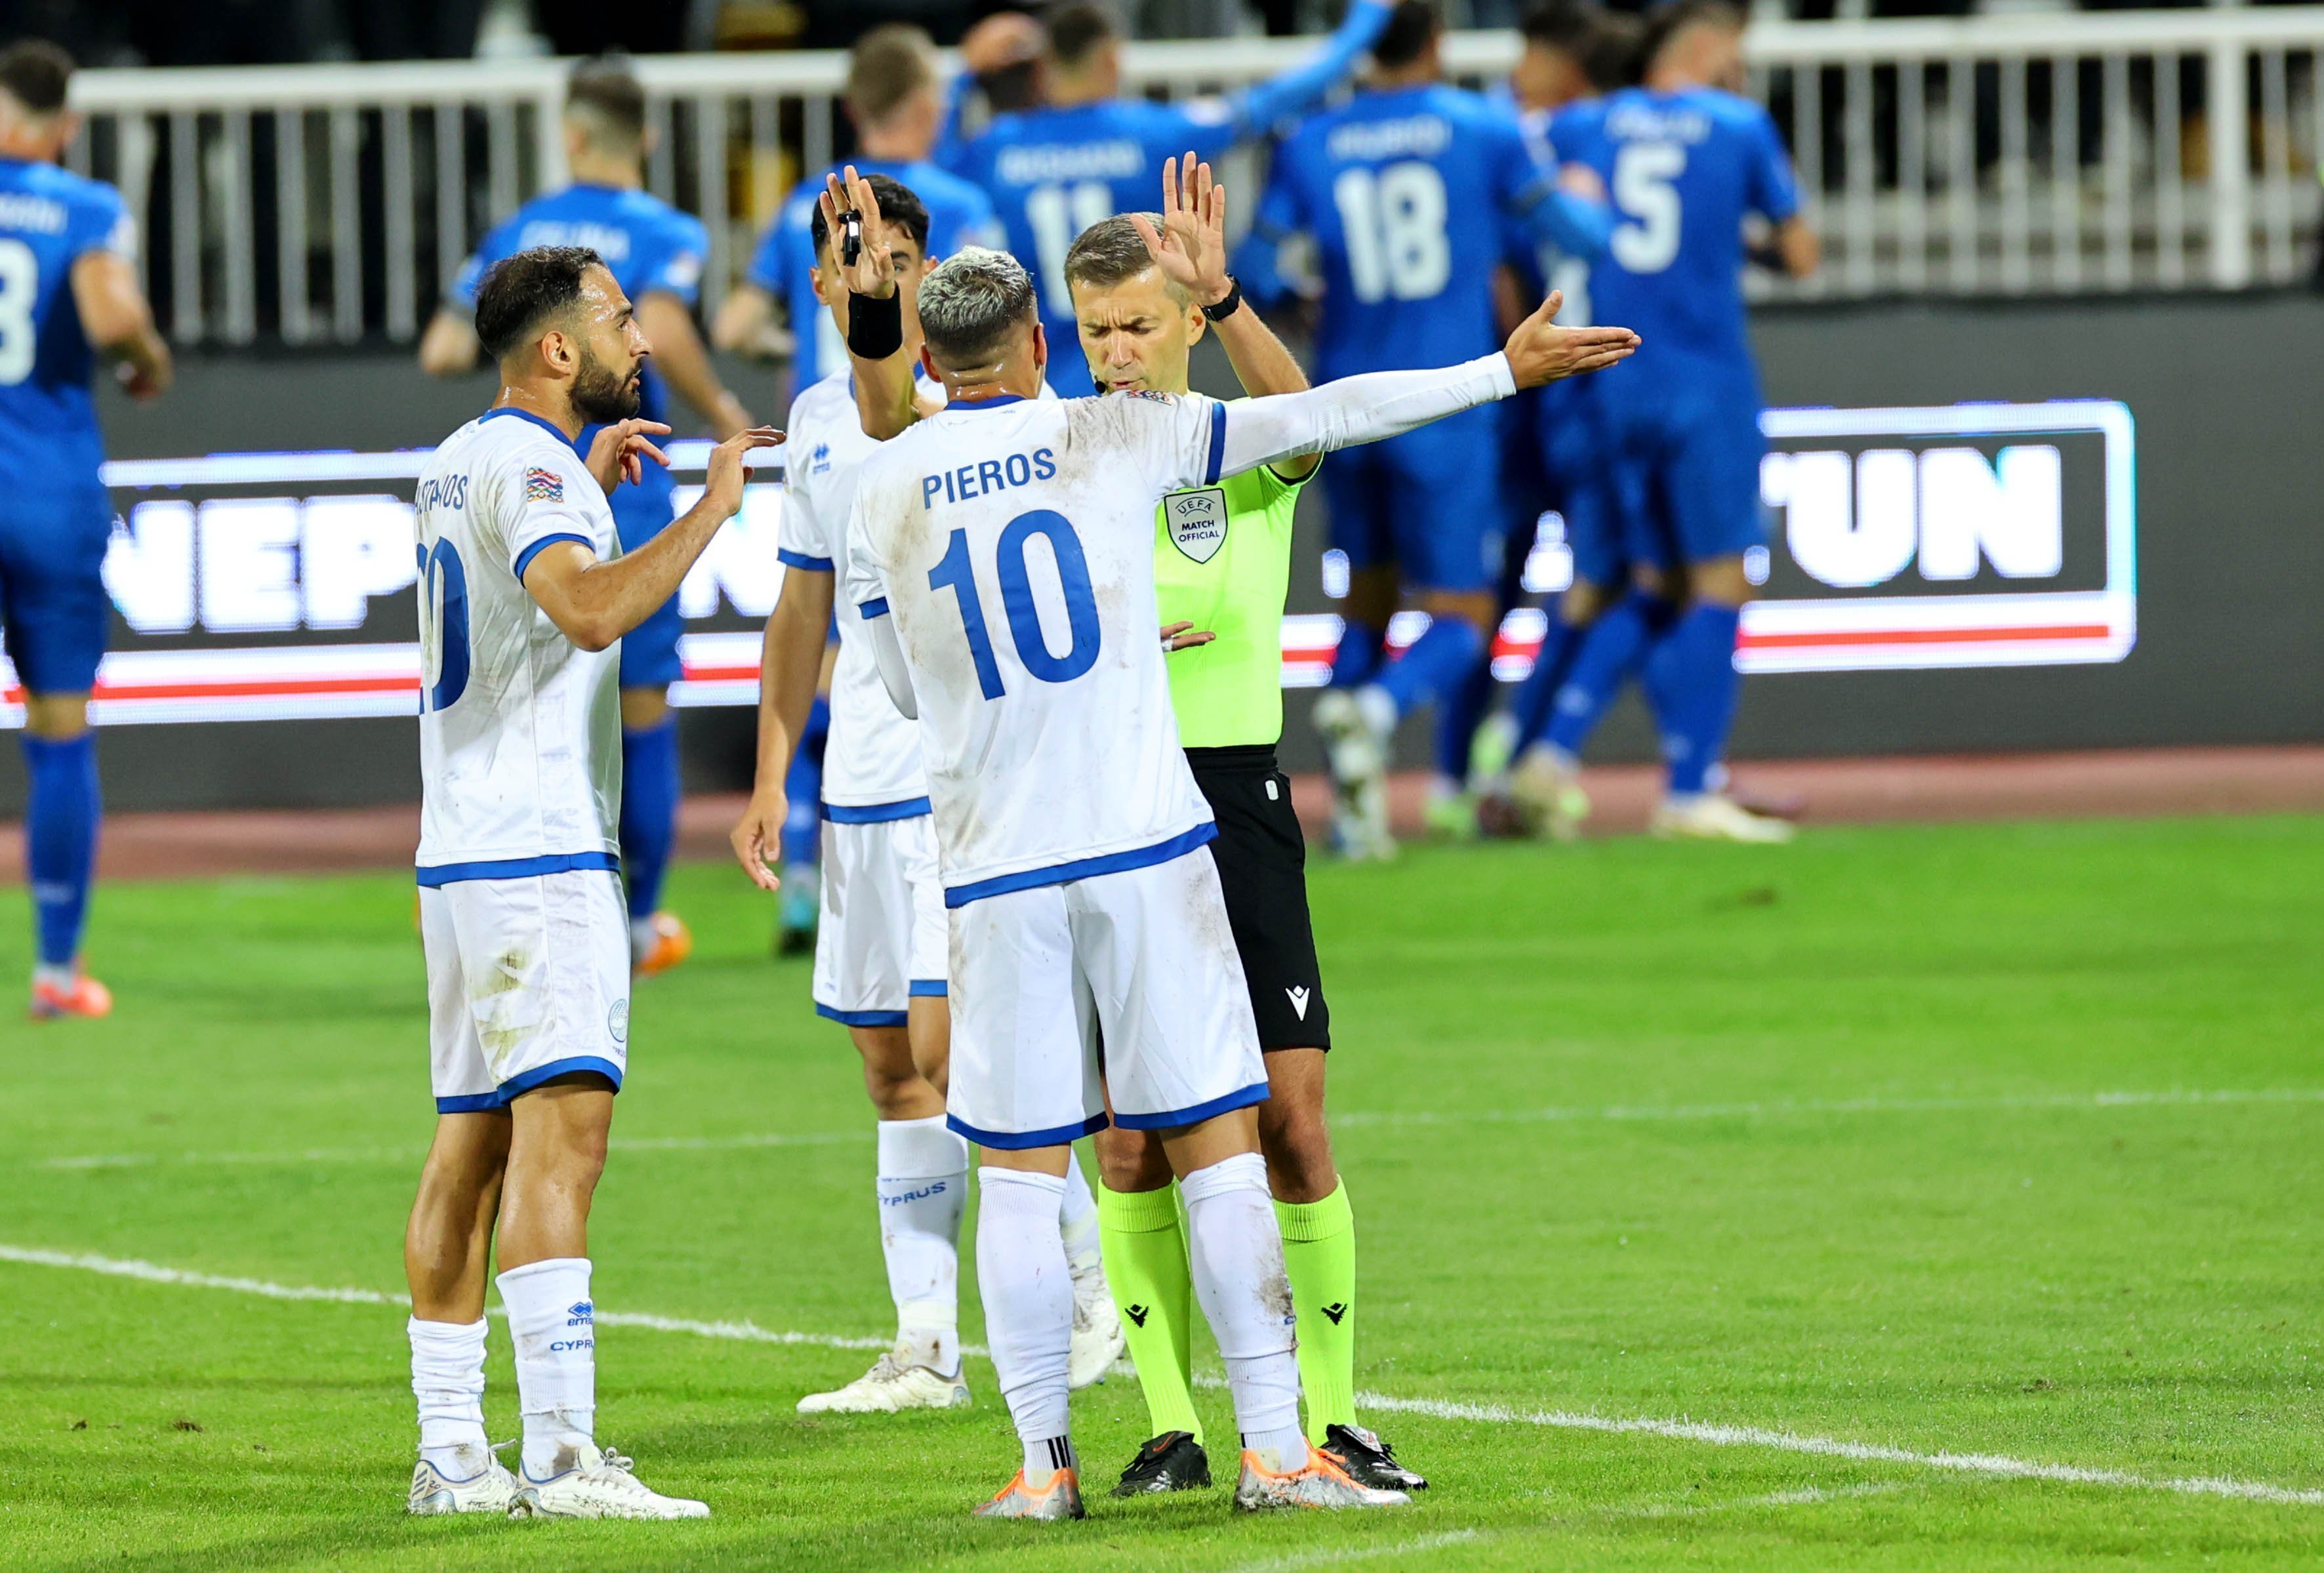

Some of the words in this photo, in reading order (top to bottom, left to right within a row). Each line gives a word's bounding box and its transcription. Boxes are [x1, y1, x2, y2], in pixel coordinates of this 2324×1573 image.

[1610, 142, 1686, 274] 5
[1334, 161, 1451, 304] 18
[922, 447, 1057, 510] PIEROS
[1178, 499, 1212, 514] UEFA
[1181, 520, 1215, 531] MATCH
[1179, 530, 1220, 542] OFFICIAL
[928, 509, 1101, 702] 10
[878, 1181, 947, 1206] YPRUS
